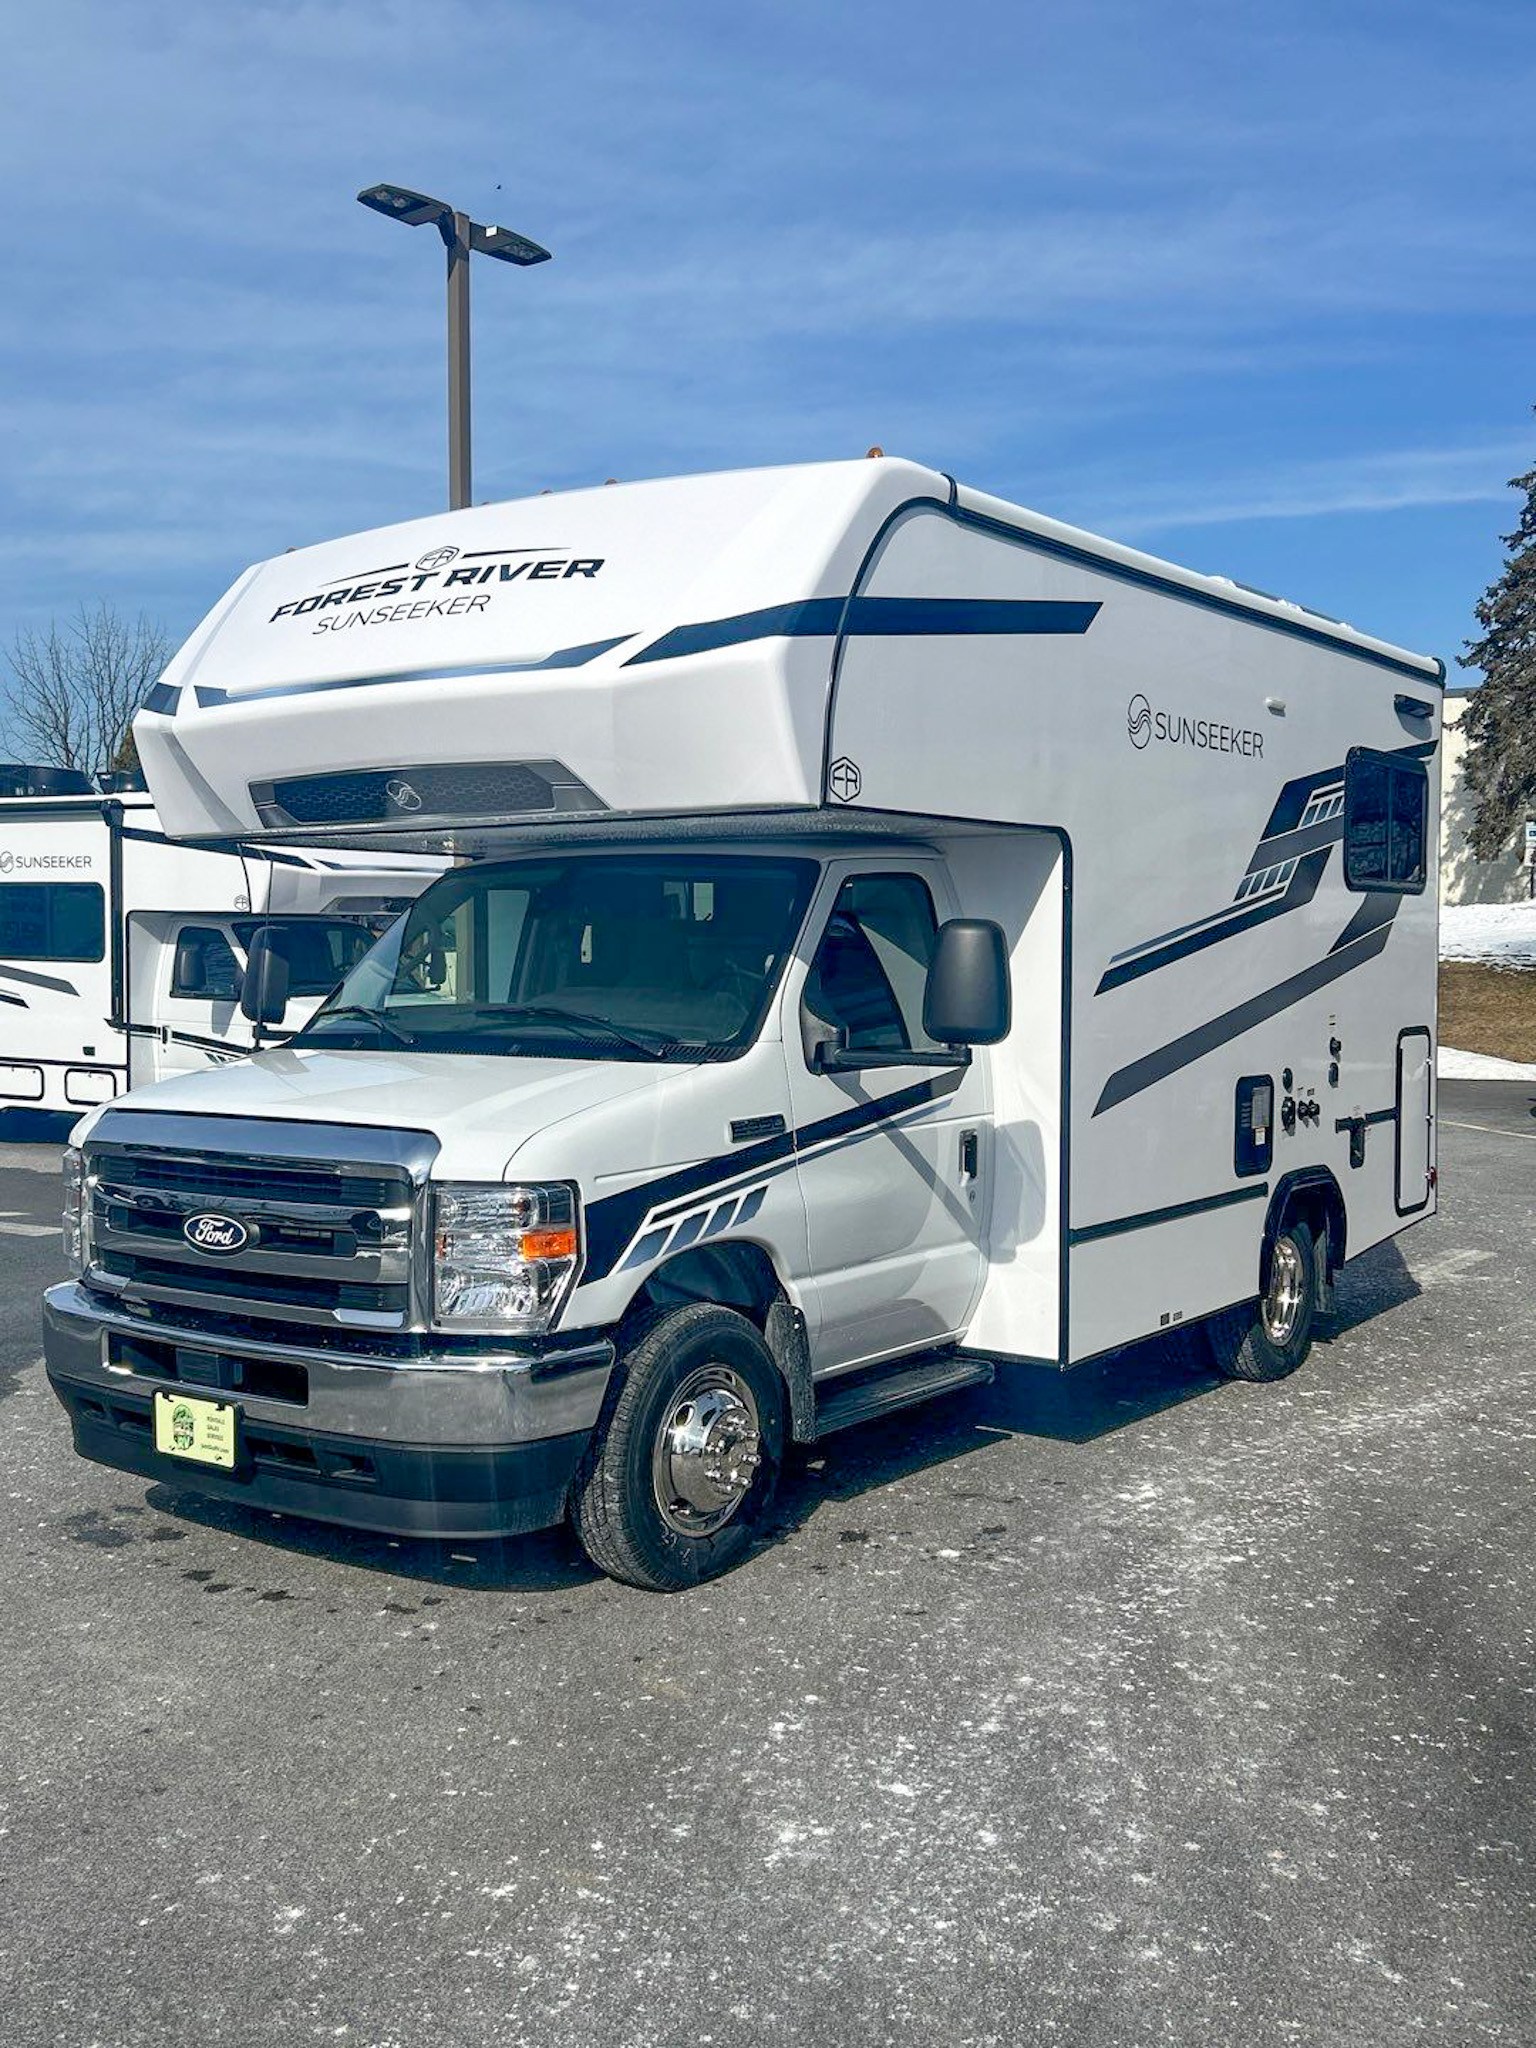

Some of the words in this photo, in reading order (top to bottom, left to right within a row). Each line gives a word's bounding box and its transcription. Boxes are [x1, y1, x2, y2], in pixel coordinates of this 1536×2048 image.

[269, 572, 440, 623] FOREST
[443, 559, 605, 588] RIVER
[312, 594, 491, 635] SUNSEEKER
[1155, 712, 1264, 759] SUNSEEKER
[15, 855, 92, 868] SUNSEEKER
[195, 1218, 235, 1246] Ford
